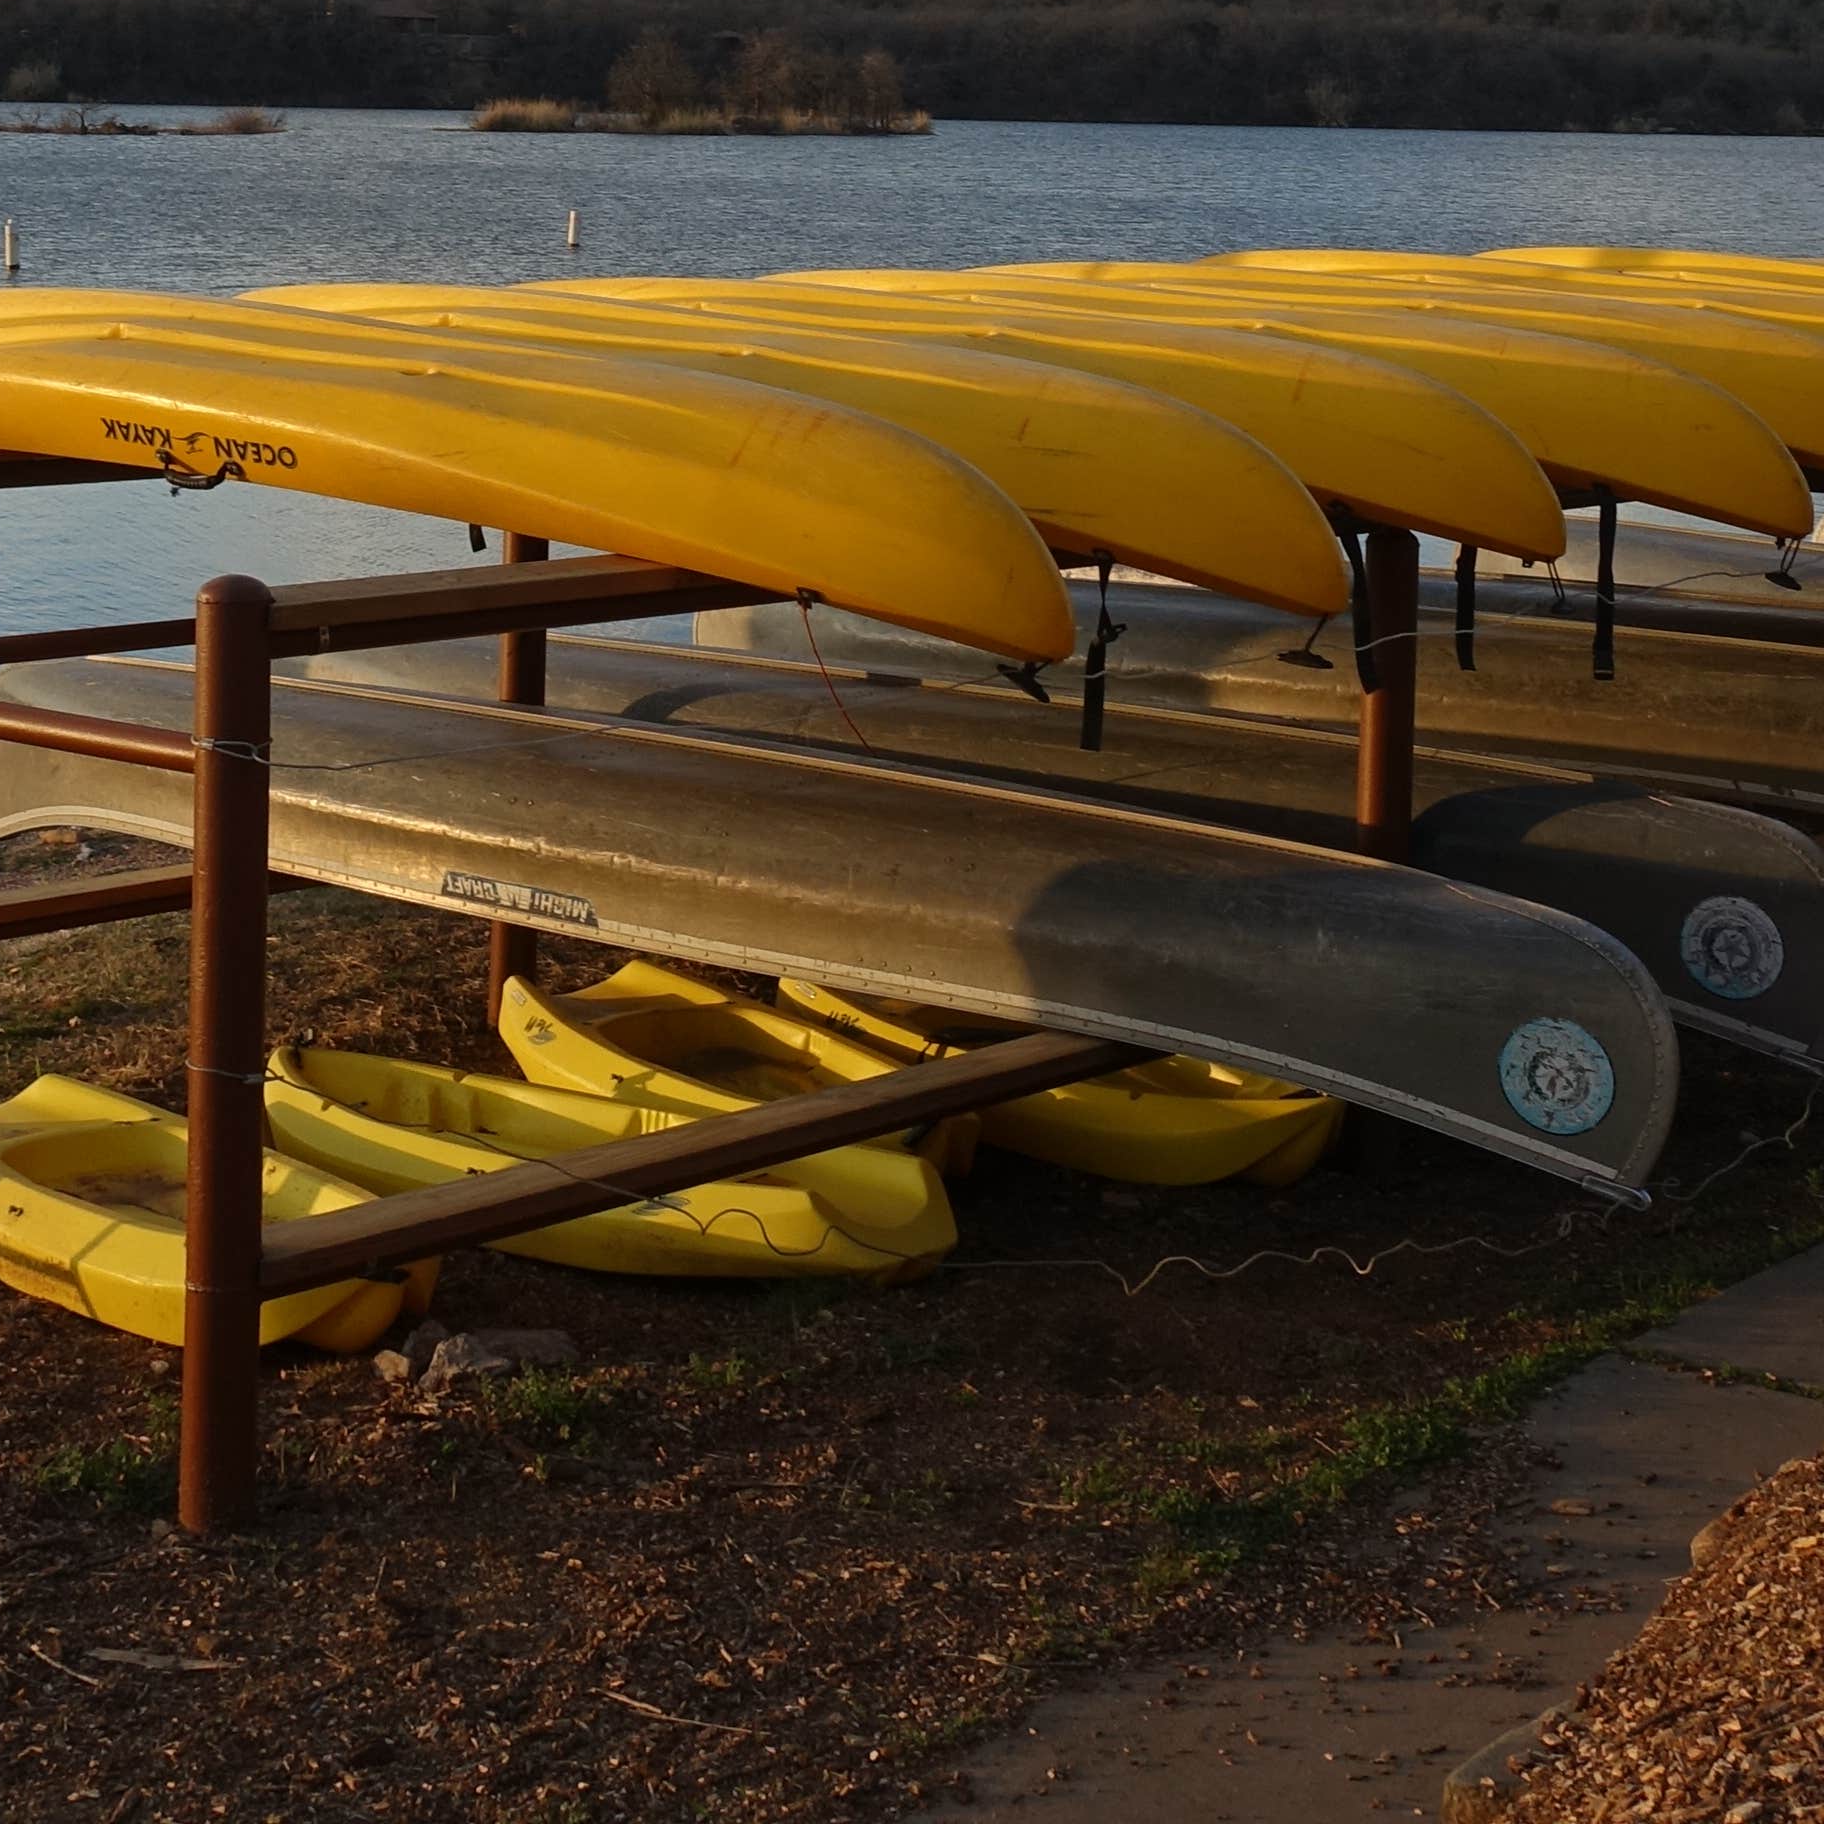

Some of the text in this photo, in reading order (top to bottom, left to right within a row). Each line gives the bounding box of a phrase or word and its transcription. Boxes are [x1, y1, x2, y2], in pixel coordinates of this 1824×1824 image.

[101, 418, 298, 469] OCEAN KAYAK
[446, 874, 497, 901] CRAFT
